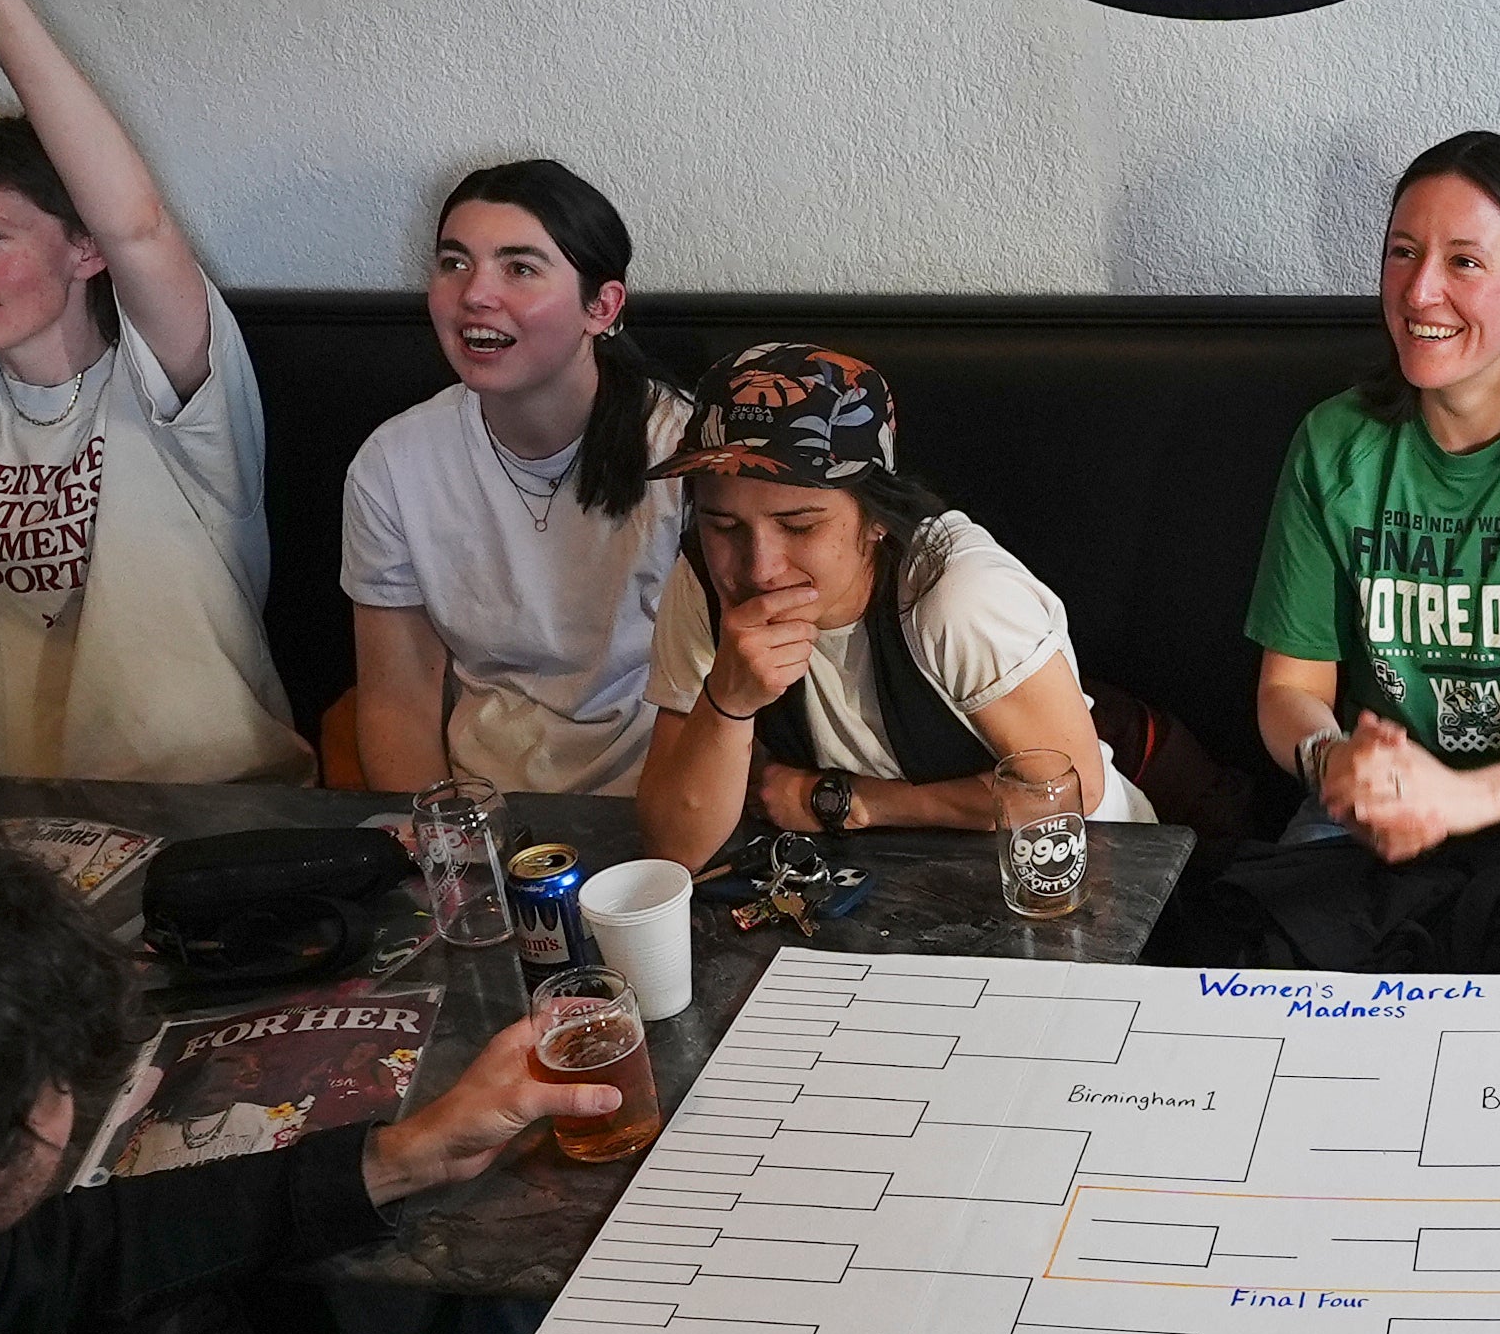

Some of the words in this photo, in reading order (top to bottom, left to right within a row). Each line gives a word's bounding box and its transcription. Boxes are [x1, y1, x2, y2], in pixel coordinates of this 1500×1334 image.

[732, 406, 772, 417] SKIDA
[1353, 526, 1463, 578] FINAL
[1036, 818, 1068, 834] THE
[1199, 972, 1334, 999] Women's
[1371, 979, 1487, 1002] March
[1286, 1000, 1408, 1019] Madness
[176, 1013, 288, 1064] FOR
[293, 1007, 421, 1034] HER
[1067, 1084, 1197, 1111] Birmingham
[1201, 1090, 1218, 1113] 1
[1230, 1288, 1306, 1309] Final
[1317, 1291, 1370, 1309] Four
